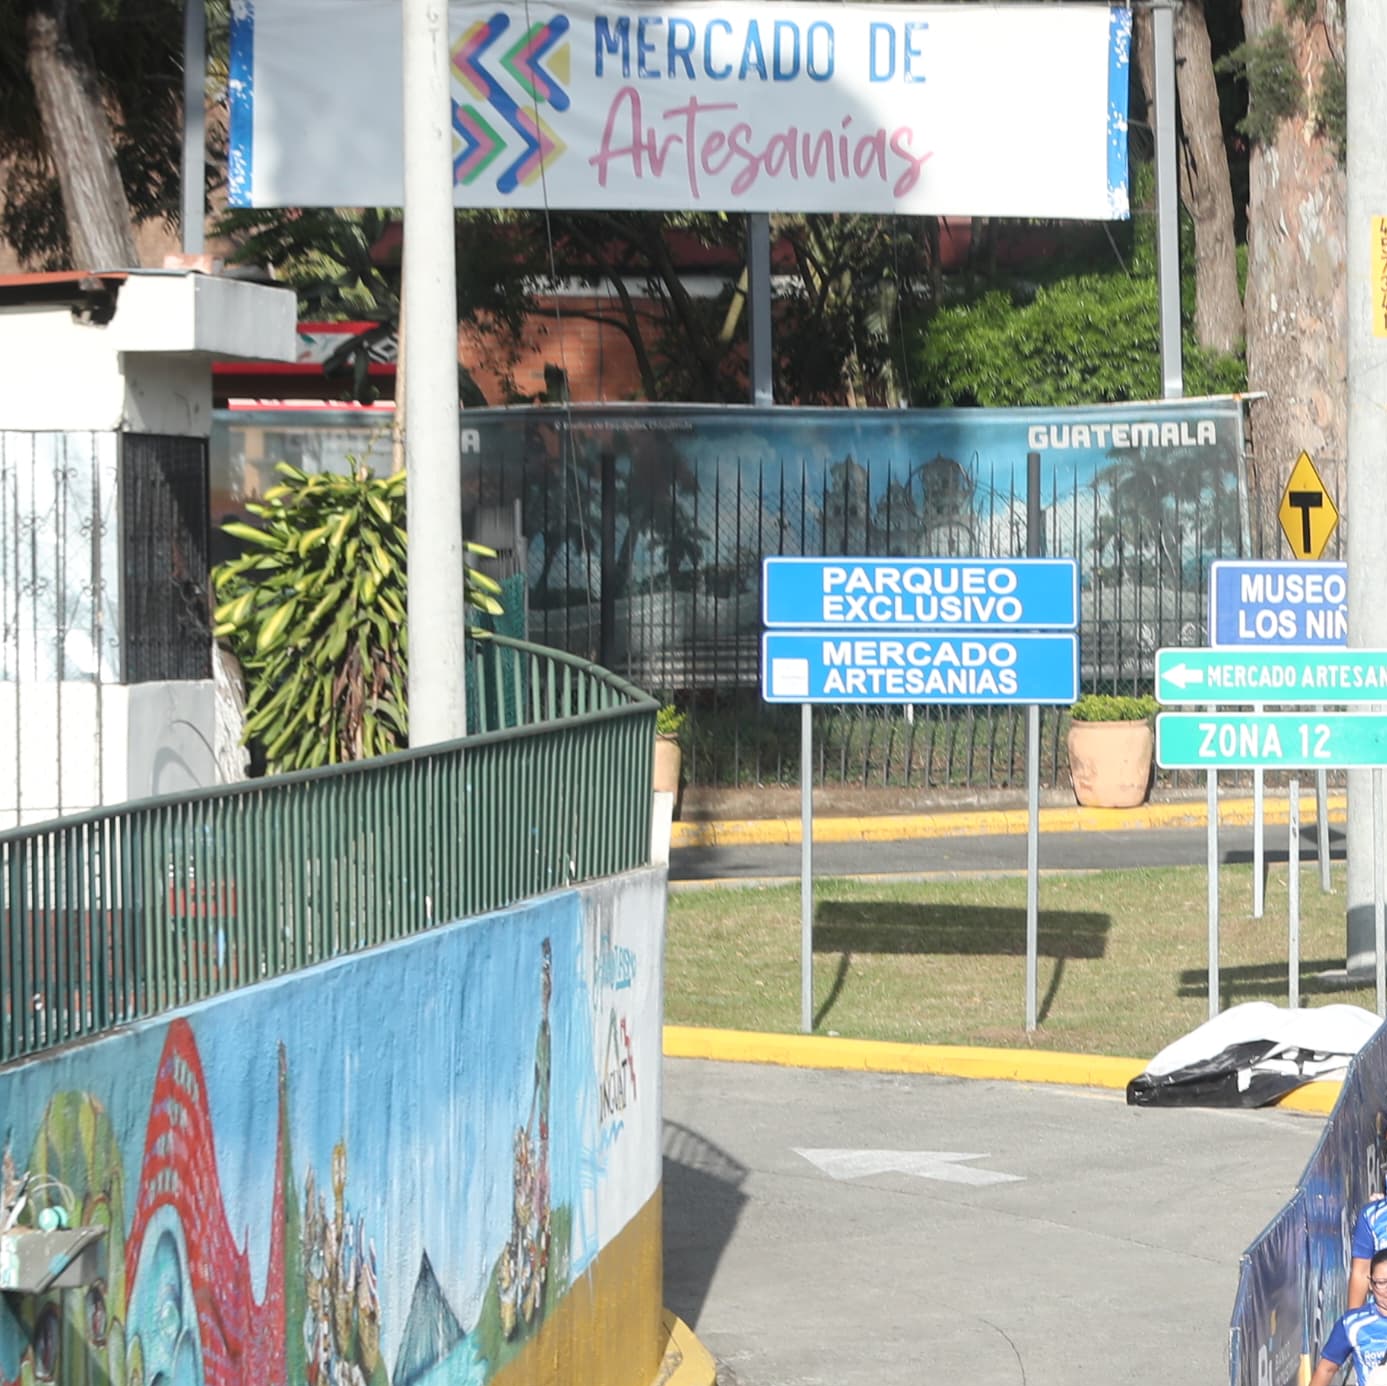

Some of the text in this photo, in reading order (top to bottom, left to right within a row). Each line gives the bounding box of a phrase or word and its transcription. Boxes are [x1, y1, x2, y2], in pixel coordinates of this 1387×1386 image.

[594, 16, 929, 83] MERCADO DE
[1029, 422, 1217, 450] GUATEMALA
[823, 567, 1018, 596] PARQUEO
[1241, 574, 1346, 604] MUSEO
[823, 596, 1022, 623] EXCLUSIVO
[1239, 611, 1296, 639] LOS
[823, 642, 1018, 668] MERCADO
[823, 668, 1018, 695] ARTESANIAS
[1207, 665, 1297, 688] MERCADO
[1198, 724, 1331, 758] ZONA 12
